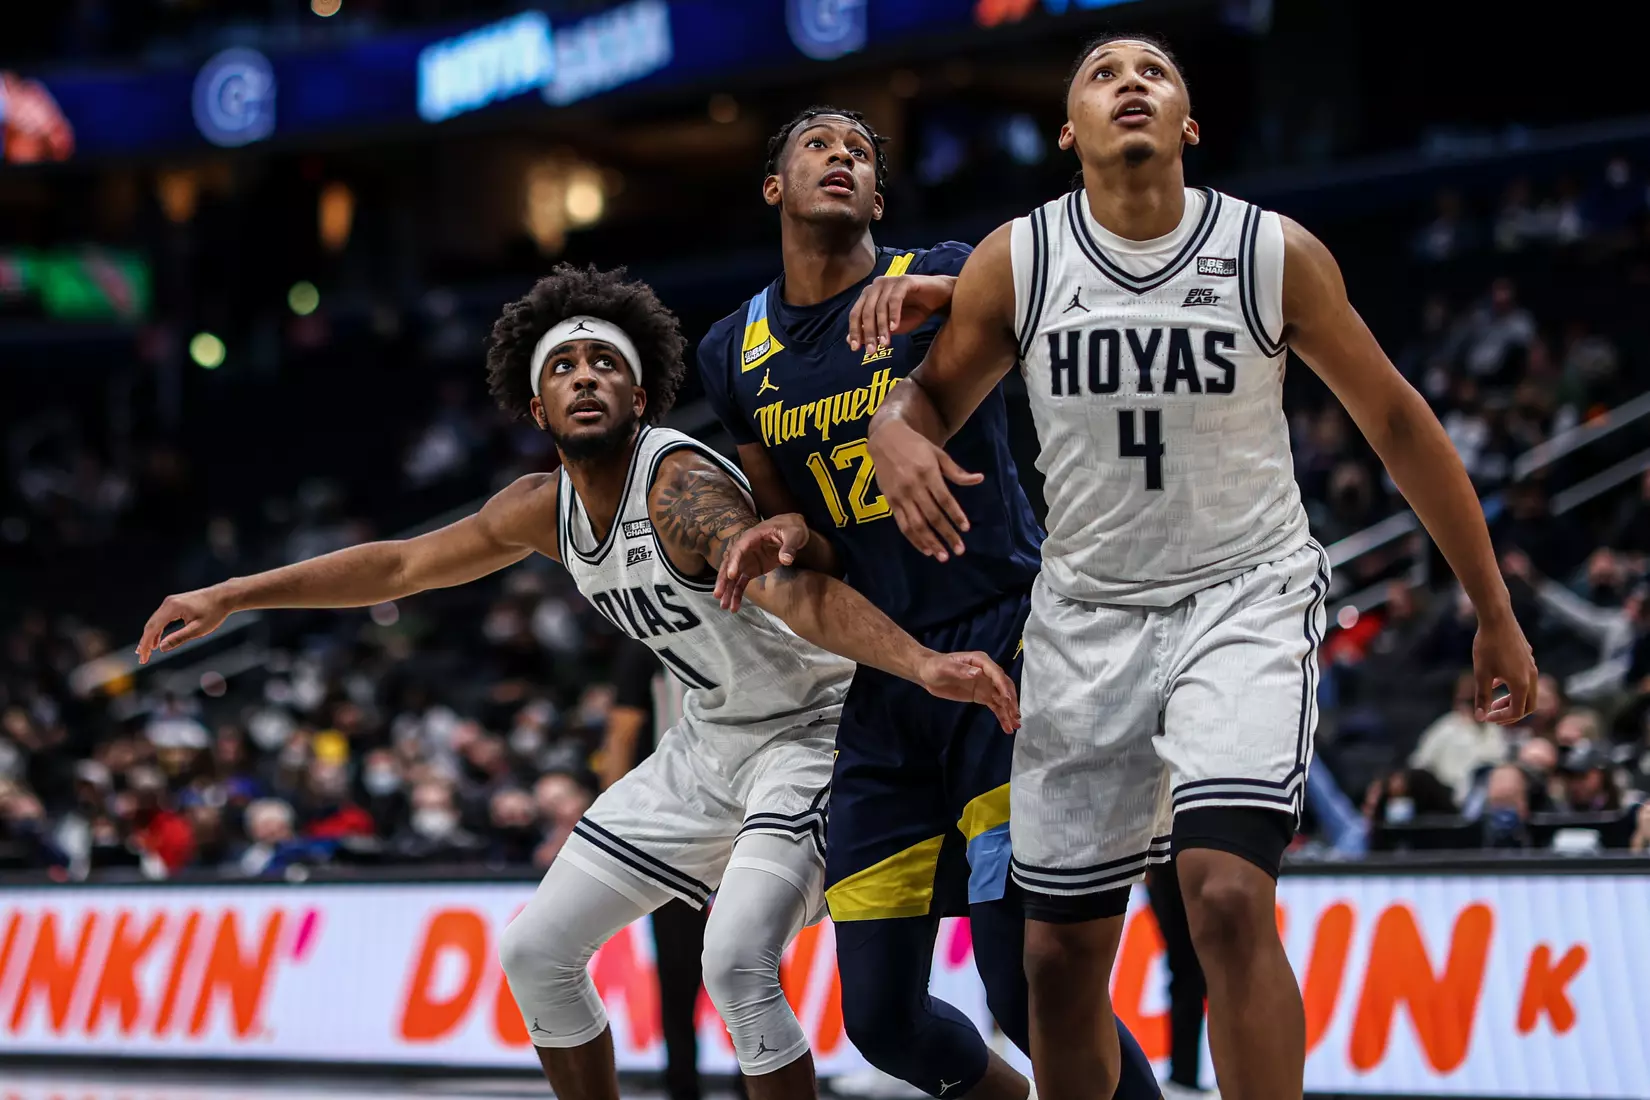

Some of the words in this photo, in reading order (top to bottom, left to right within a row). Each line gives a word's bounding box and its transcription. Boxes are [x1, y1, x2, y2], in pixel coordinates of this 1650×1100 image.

[1183, 296, 1221, 304] EAST
[1188, 288, 1214, 297] BIG
[862, 347, 894, 362] EAST
[1047, 327, 1237, 396] HOYAS
[1117, 409, 1166, 491] 4
[806, 437, 894, 529] 12
[626, 550, 653, 563] EAST
[627, 545, 646, 557] BIG
[1516, 943, 1588, 1035] K
